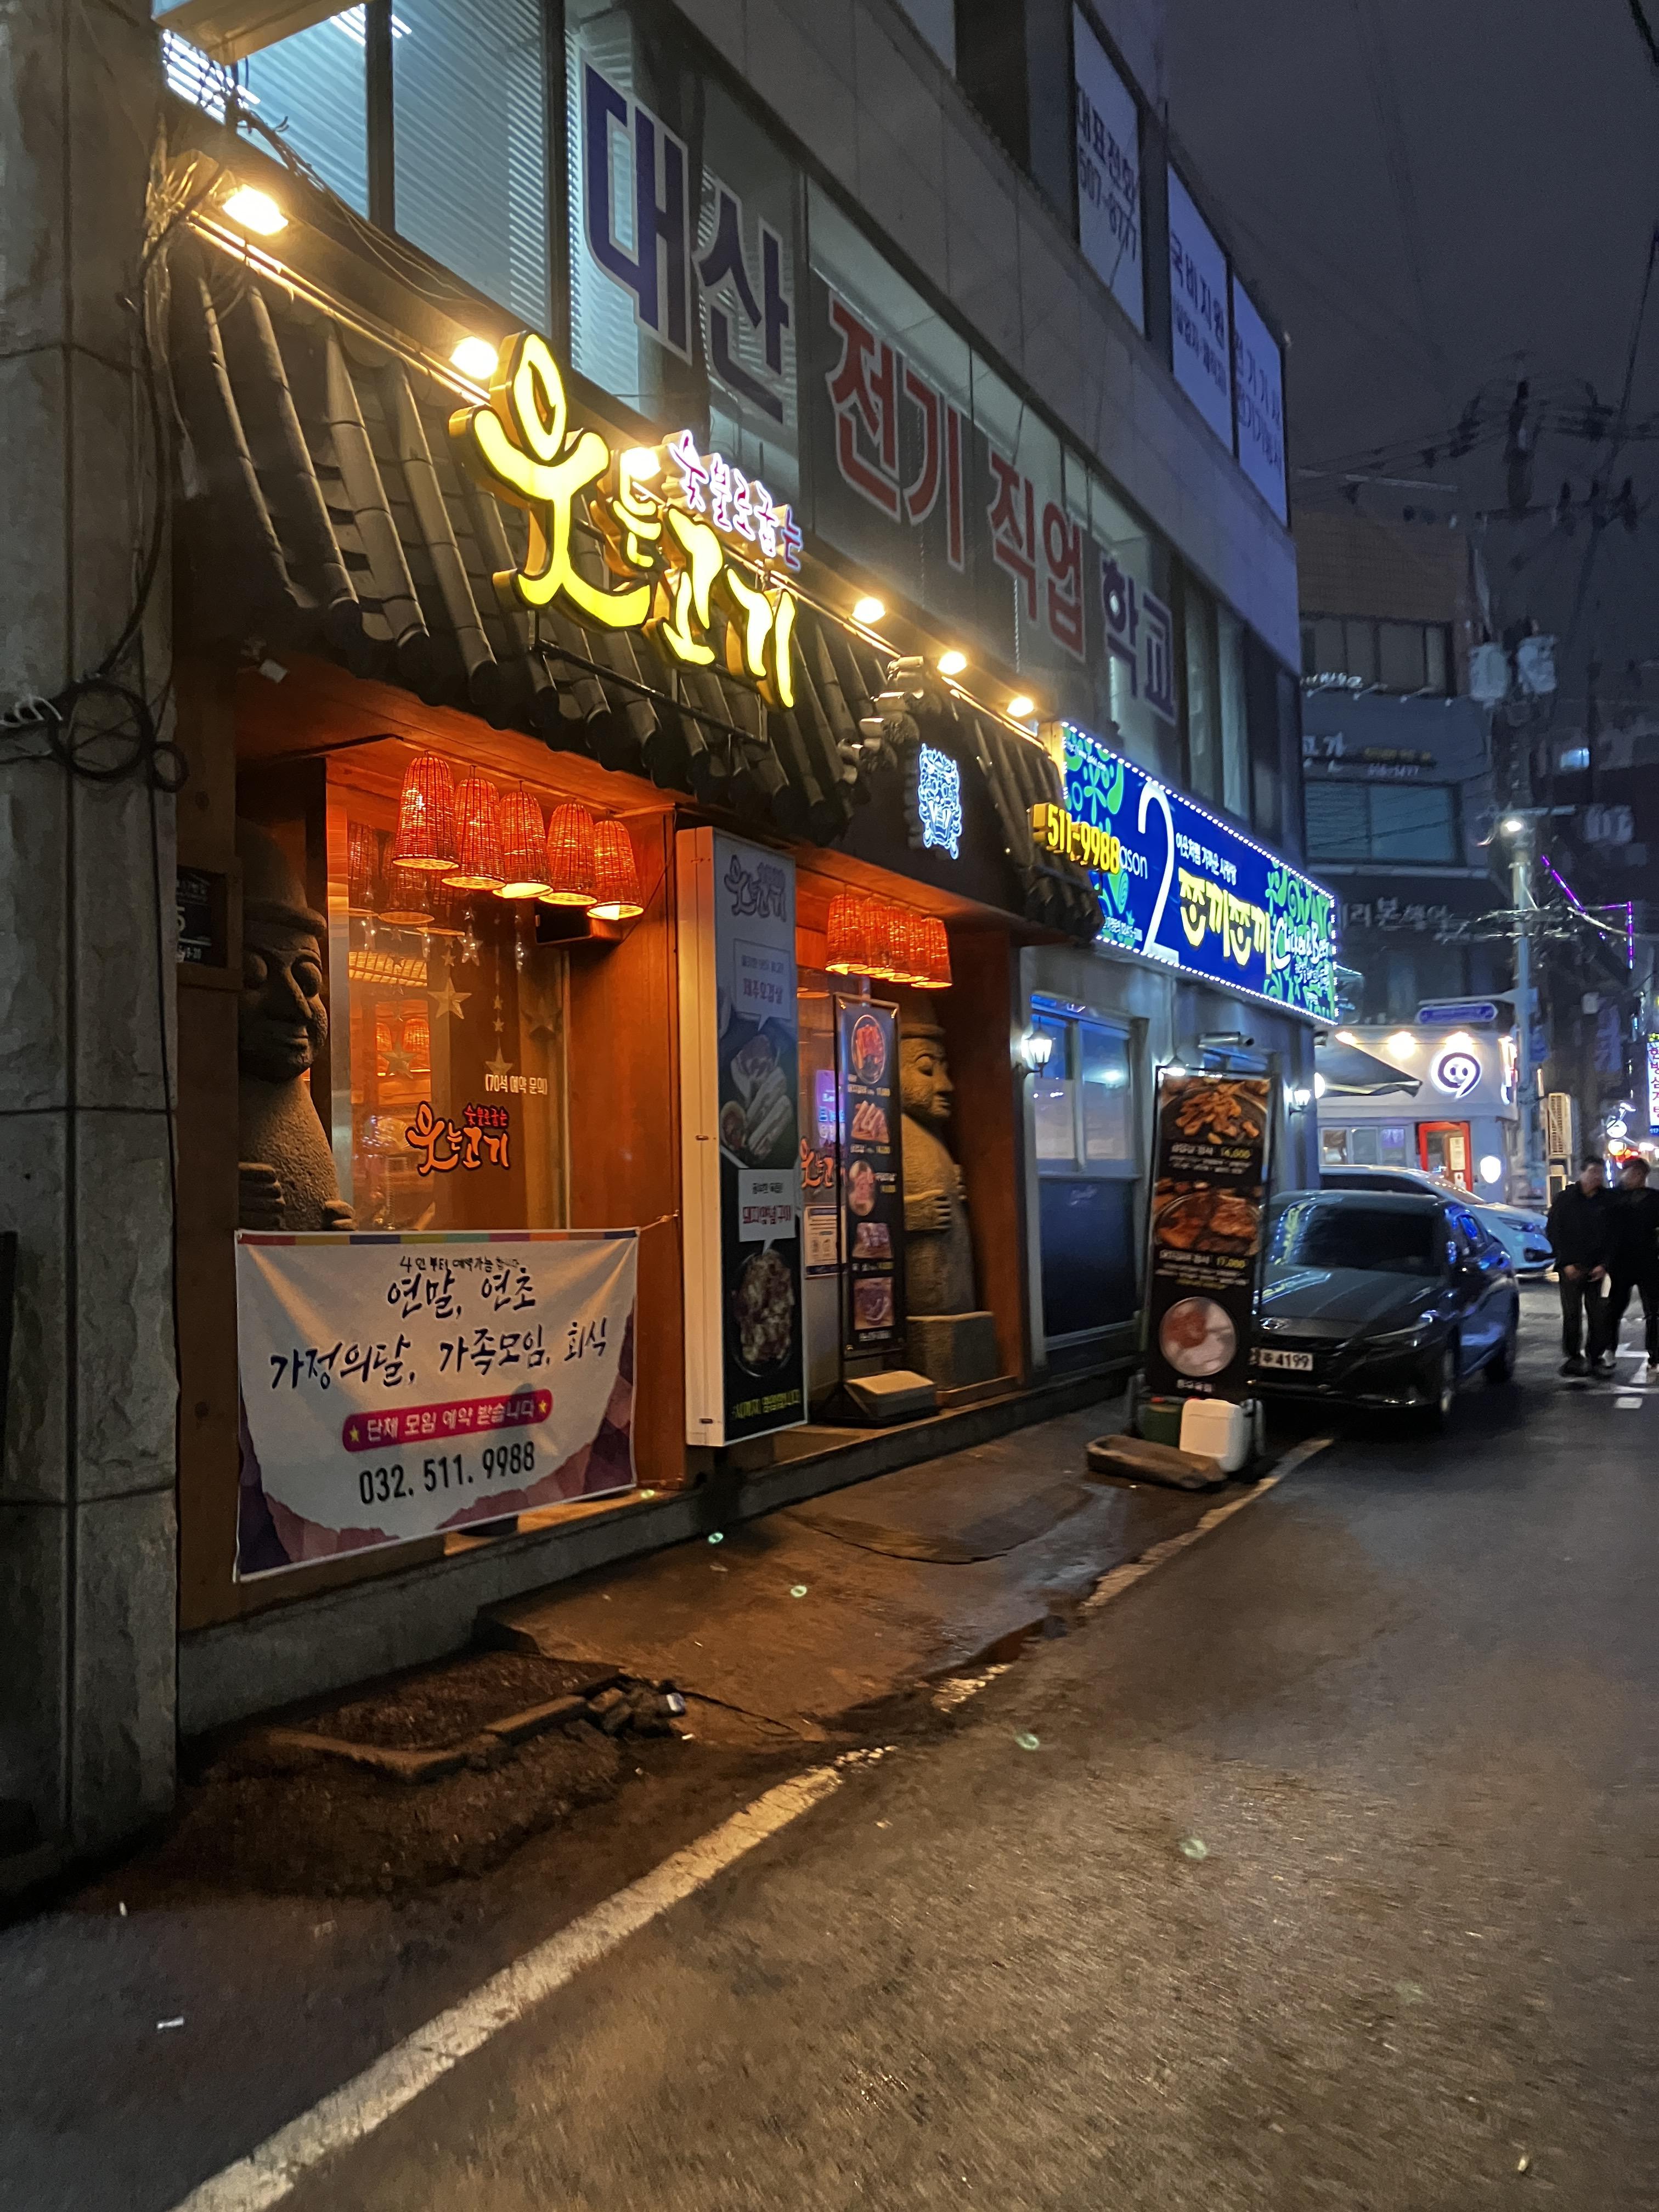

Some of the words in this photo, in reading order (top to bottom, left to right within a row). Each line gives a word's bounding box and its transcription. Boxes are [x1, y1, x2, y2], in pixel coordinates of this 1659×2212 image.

[583, 61, 791, 427] 대산
[827, 295, 964, 571] 전기
[988, 451, 1085, 662] 직업
[1101, 555, 1175, 724] 학교
[471, 332, 798, 710] 웃는고기
[1047, 803, 1120, 874] 511-9988
[1119, 845, 1148, 879] ason
[387, 1269, 461, 1319] 연말,
[481, 1267, 535, 1311] 연초
[564, 1318, 607, 1361] 회식
[367, 1416, 399, 1443] 단체
[404, 1412, 437, 1437] 모임
[443, 1406, 473, 1430] 예약
[477, 1398, 535, 1426] 받습니다
[359, 1465, 414, 1505] 032.
[423, 1454, 474, 1493] 511.
[482, 1441, 535, 1480] 9988
